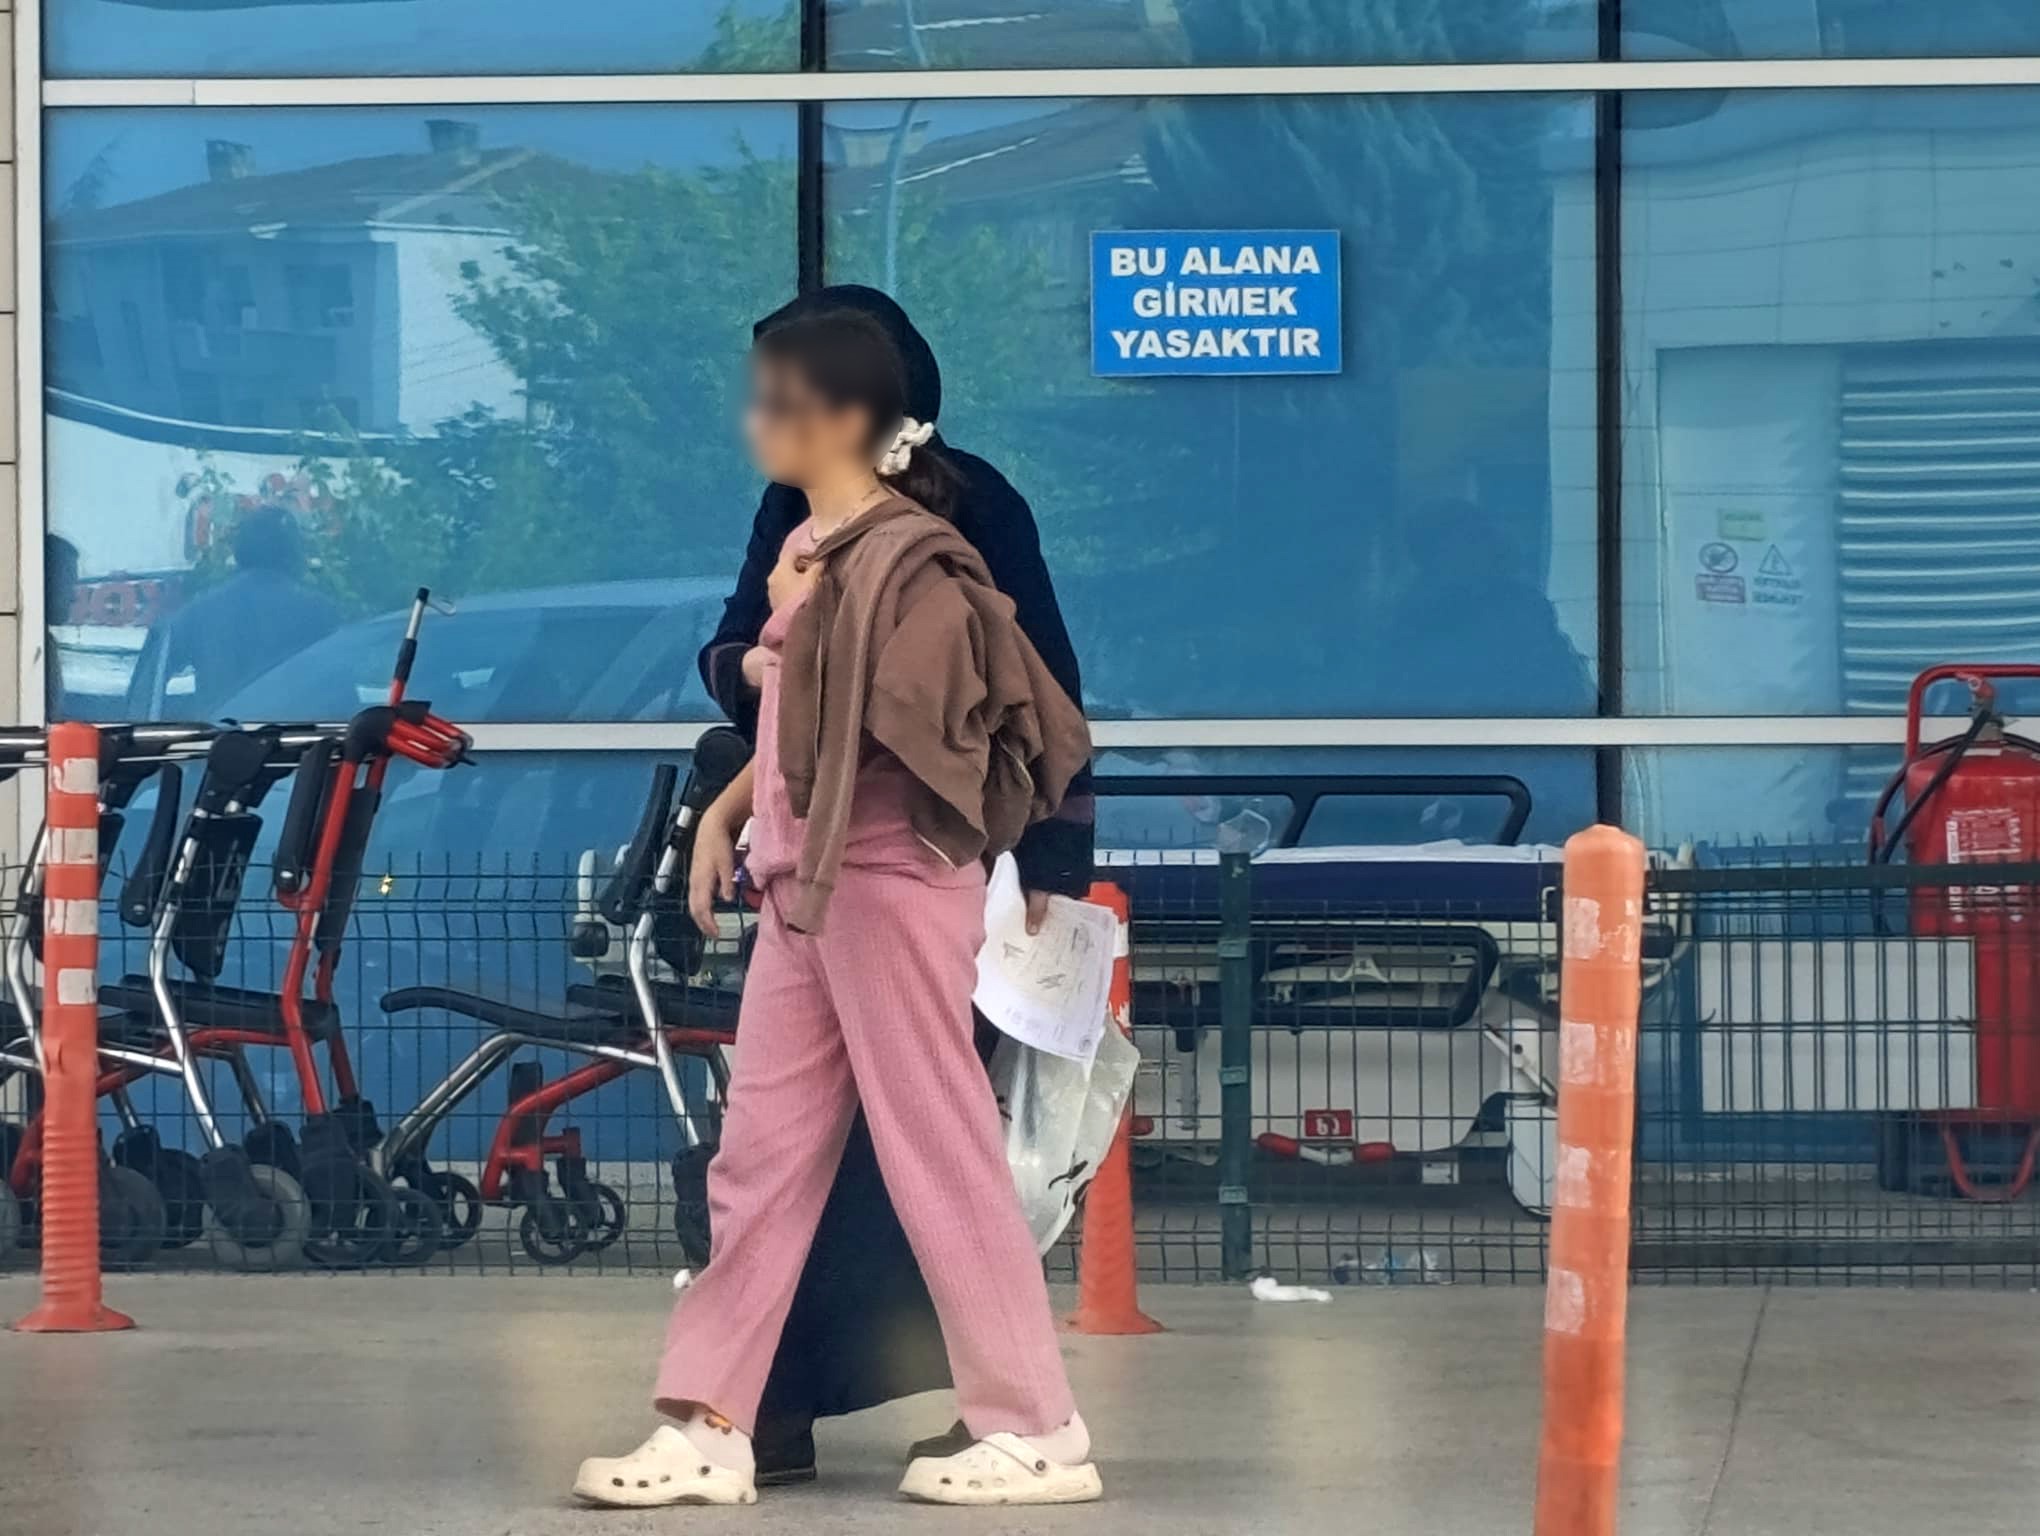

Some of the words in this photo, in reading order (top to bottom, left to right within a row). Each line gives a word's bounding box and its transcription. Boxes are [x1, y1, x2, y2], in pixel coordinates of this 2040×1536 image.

[1111, 247, 1167, 276] BU
[1180, 245, 1321, 275] ALANA
[1133, 281, 1298, 318] GİRMEK
[1112, 327, 1321, 359] YASAKTIR
